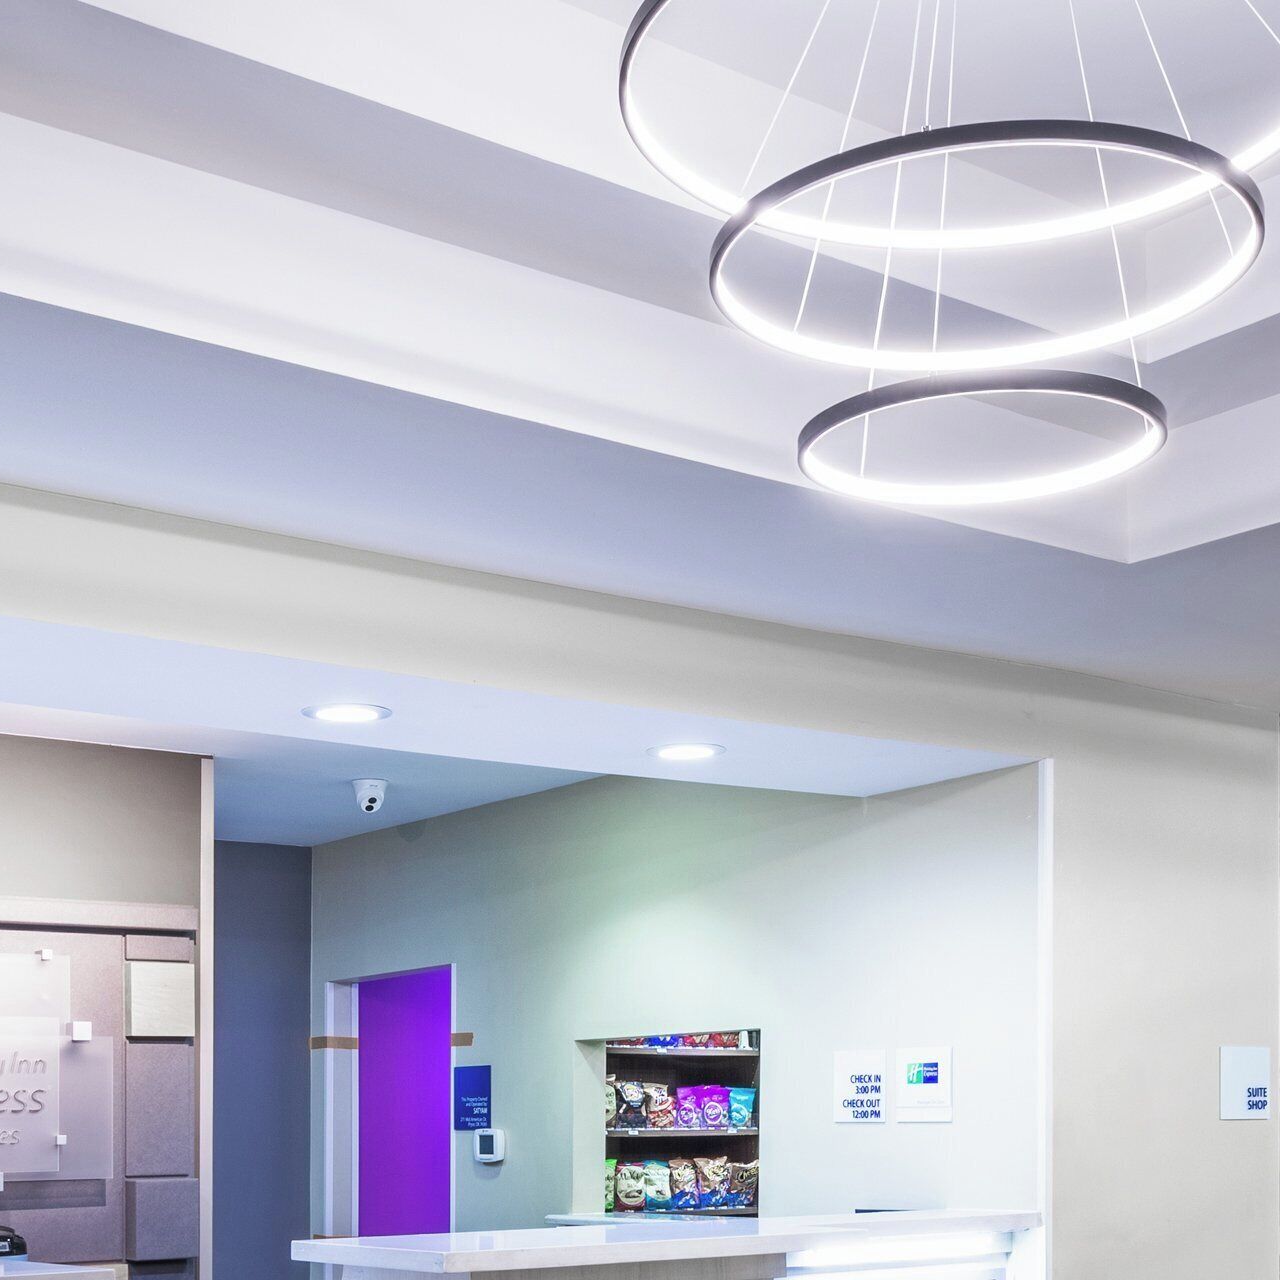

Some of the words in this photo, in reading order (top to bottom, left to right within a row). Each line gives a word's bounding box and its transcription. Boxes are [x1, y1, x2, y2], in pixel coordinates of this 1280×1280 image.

[10, 1051, 48, 1074] Inn
[850, 1074, 872, 1083] CHECK
[873, 1074, 881, 1083] IN
[855, 1085, 869, 1094] 3:00
[870, 1085, 881, 1094] PM
[1247, 1087, 1267, 1097] SUITE
[842, 1099, 865, 1108] CHECK
[865, 1098, 880, 1107] OUT
[1247, 1099, 1268, 1110] SHOP
[852, 1110, 869, 1119] 12:00
[870, 1110, 881, 1118] PM
